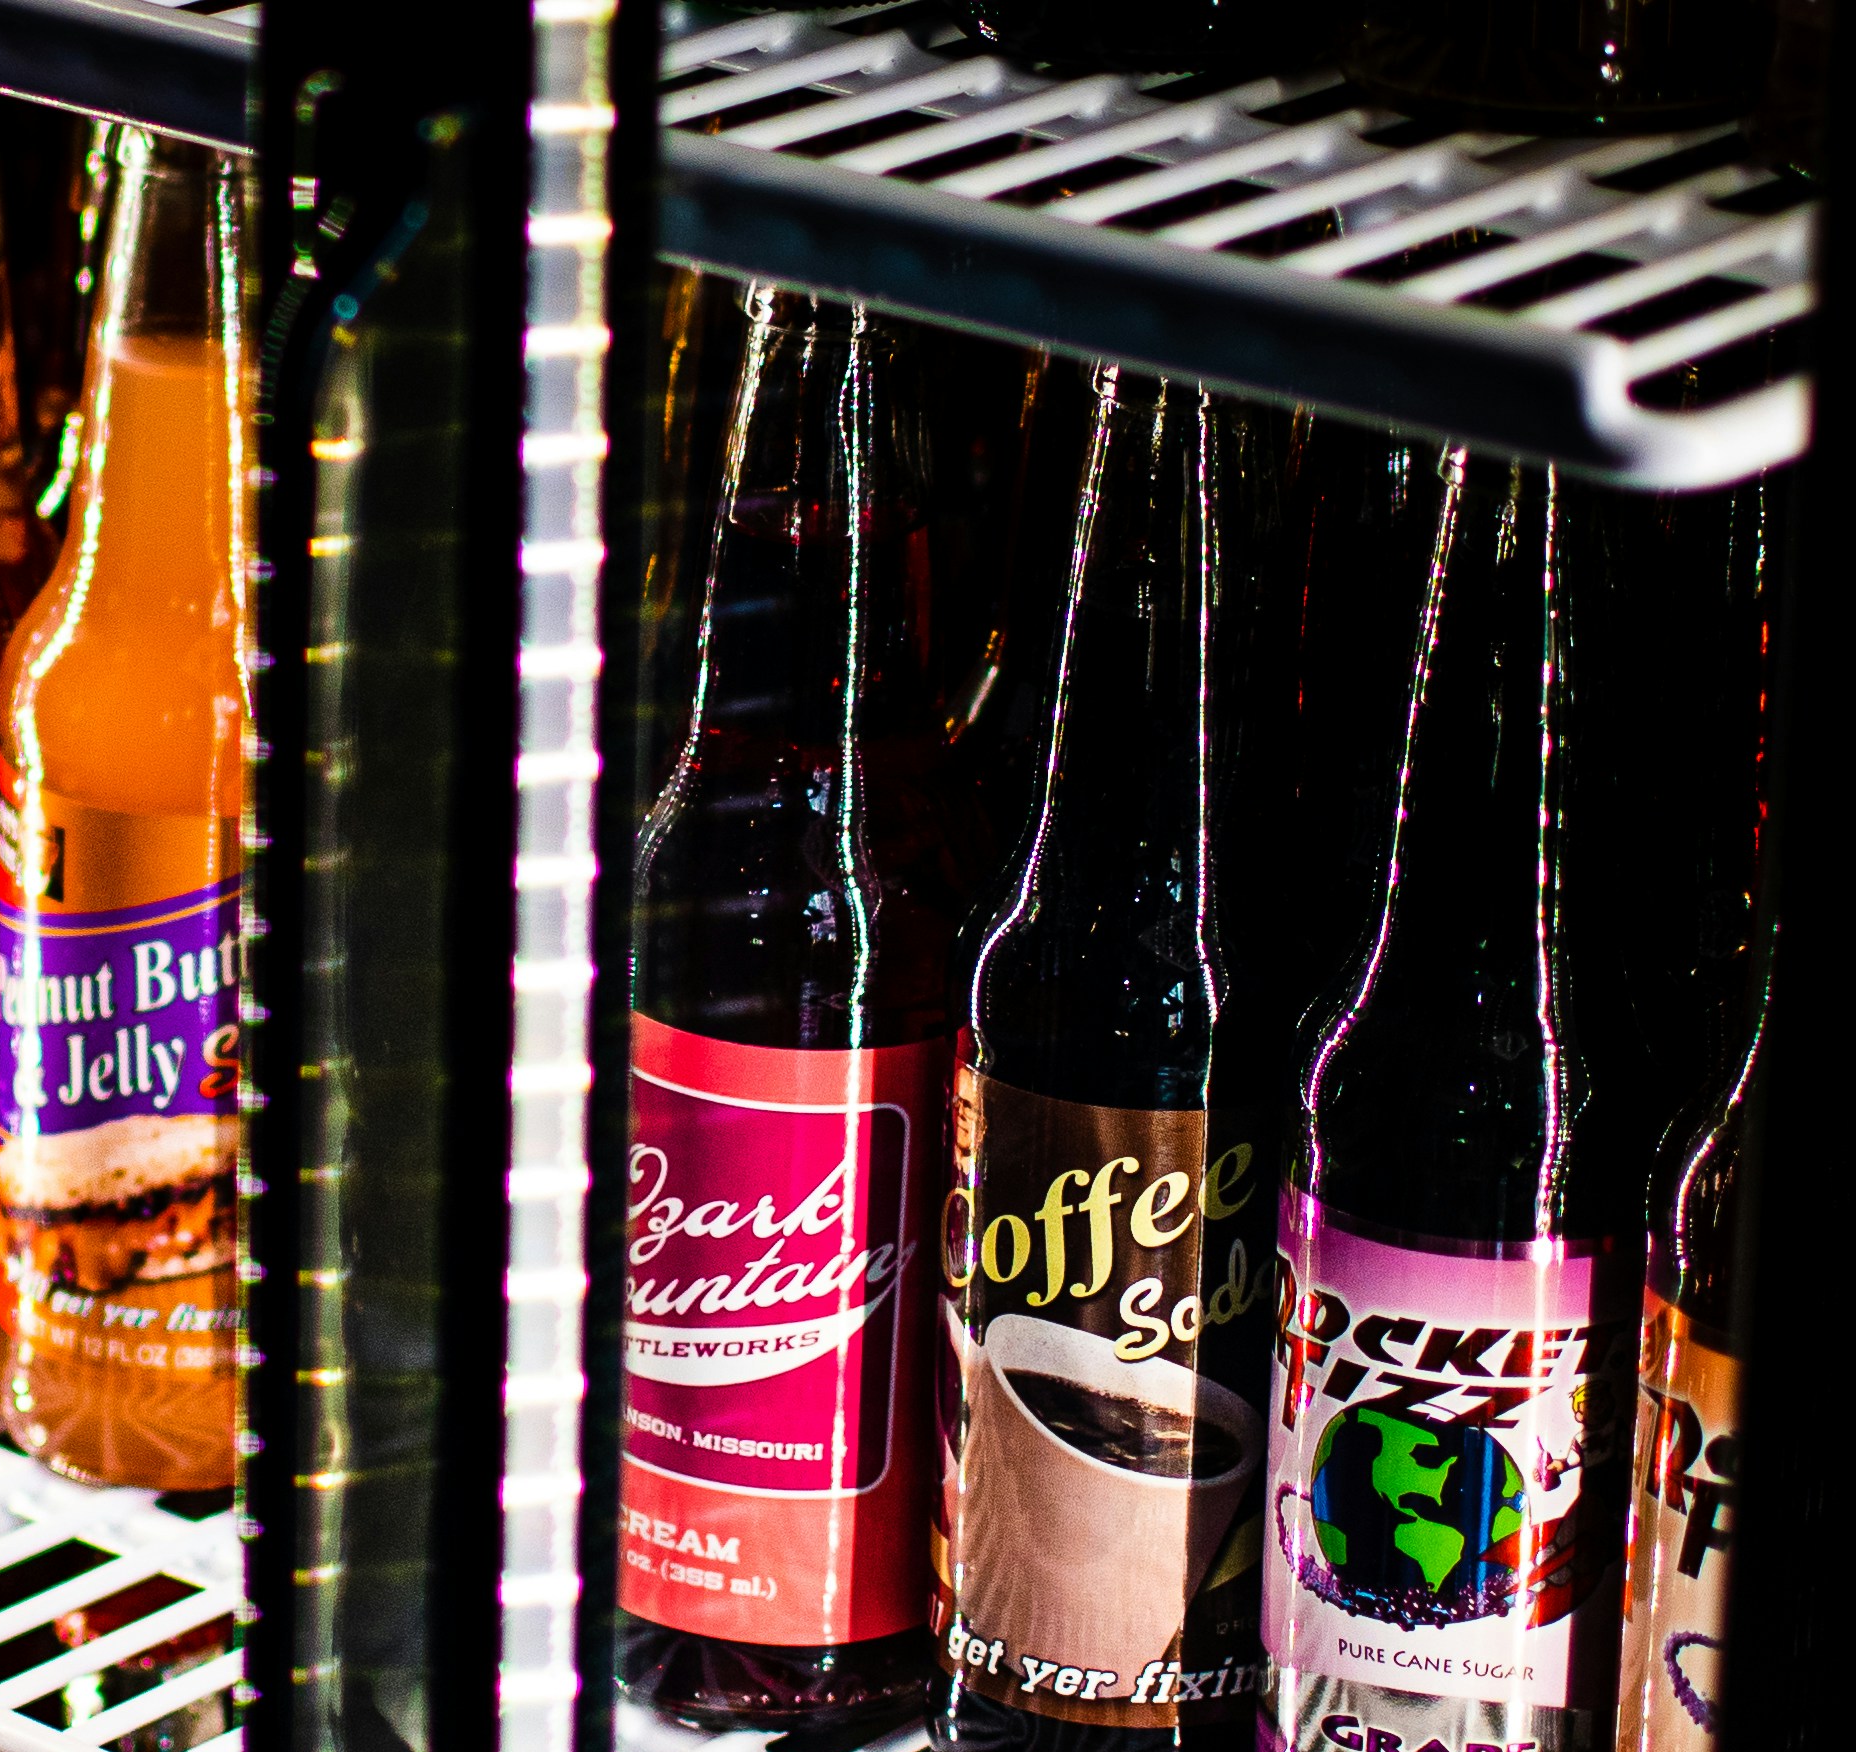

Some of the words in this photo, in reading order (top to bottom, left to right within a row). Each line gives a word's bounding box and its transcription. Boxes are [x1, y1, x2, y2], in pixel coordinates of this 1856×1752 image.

[58, 1023, 185, 1109] Jelly
[940, 1142, 1256, 1308] Coffee
[1273, 1252, 1630, 1378] ROCKET
[1282, 1328, 1554, 1434] FIZZ
[692, 1430, 825, 1461] MISSOURI
[661, 1558, 725, 1592] (355
[948, 1622, 1005, 1676] get
[1020, 1654, 1119, 1701] yer
[1338, 1638, 1385, 1664] PURE
[1394, 1650, 1452, 1675] CANE
[1462, 1659, 1534, 1682] SUGAR
